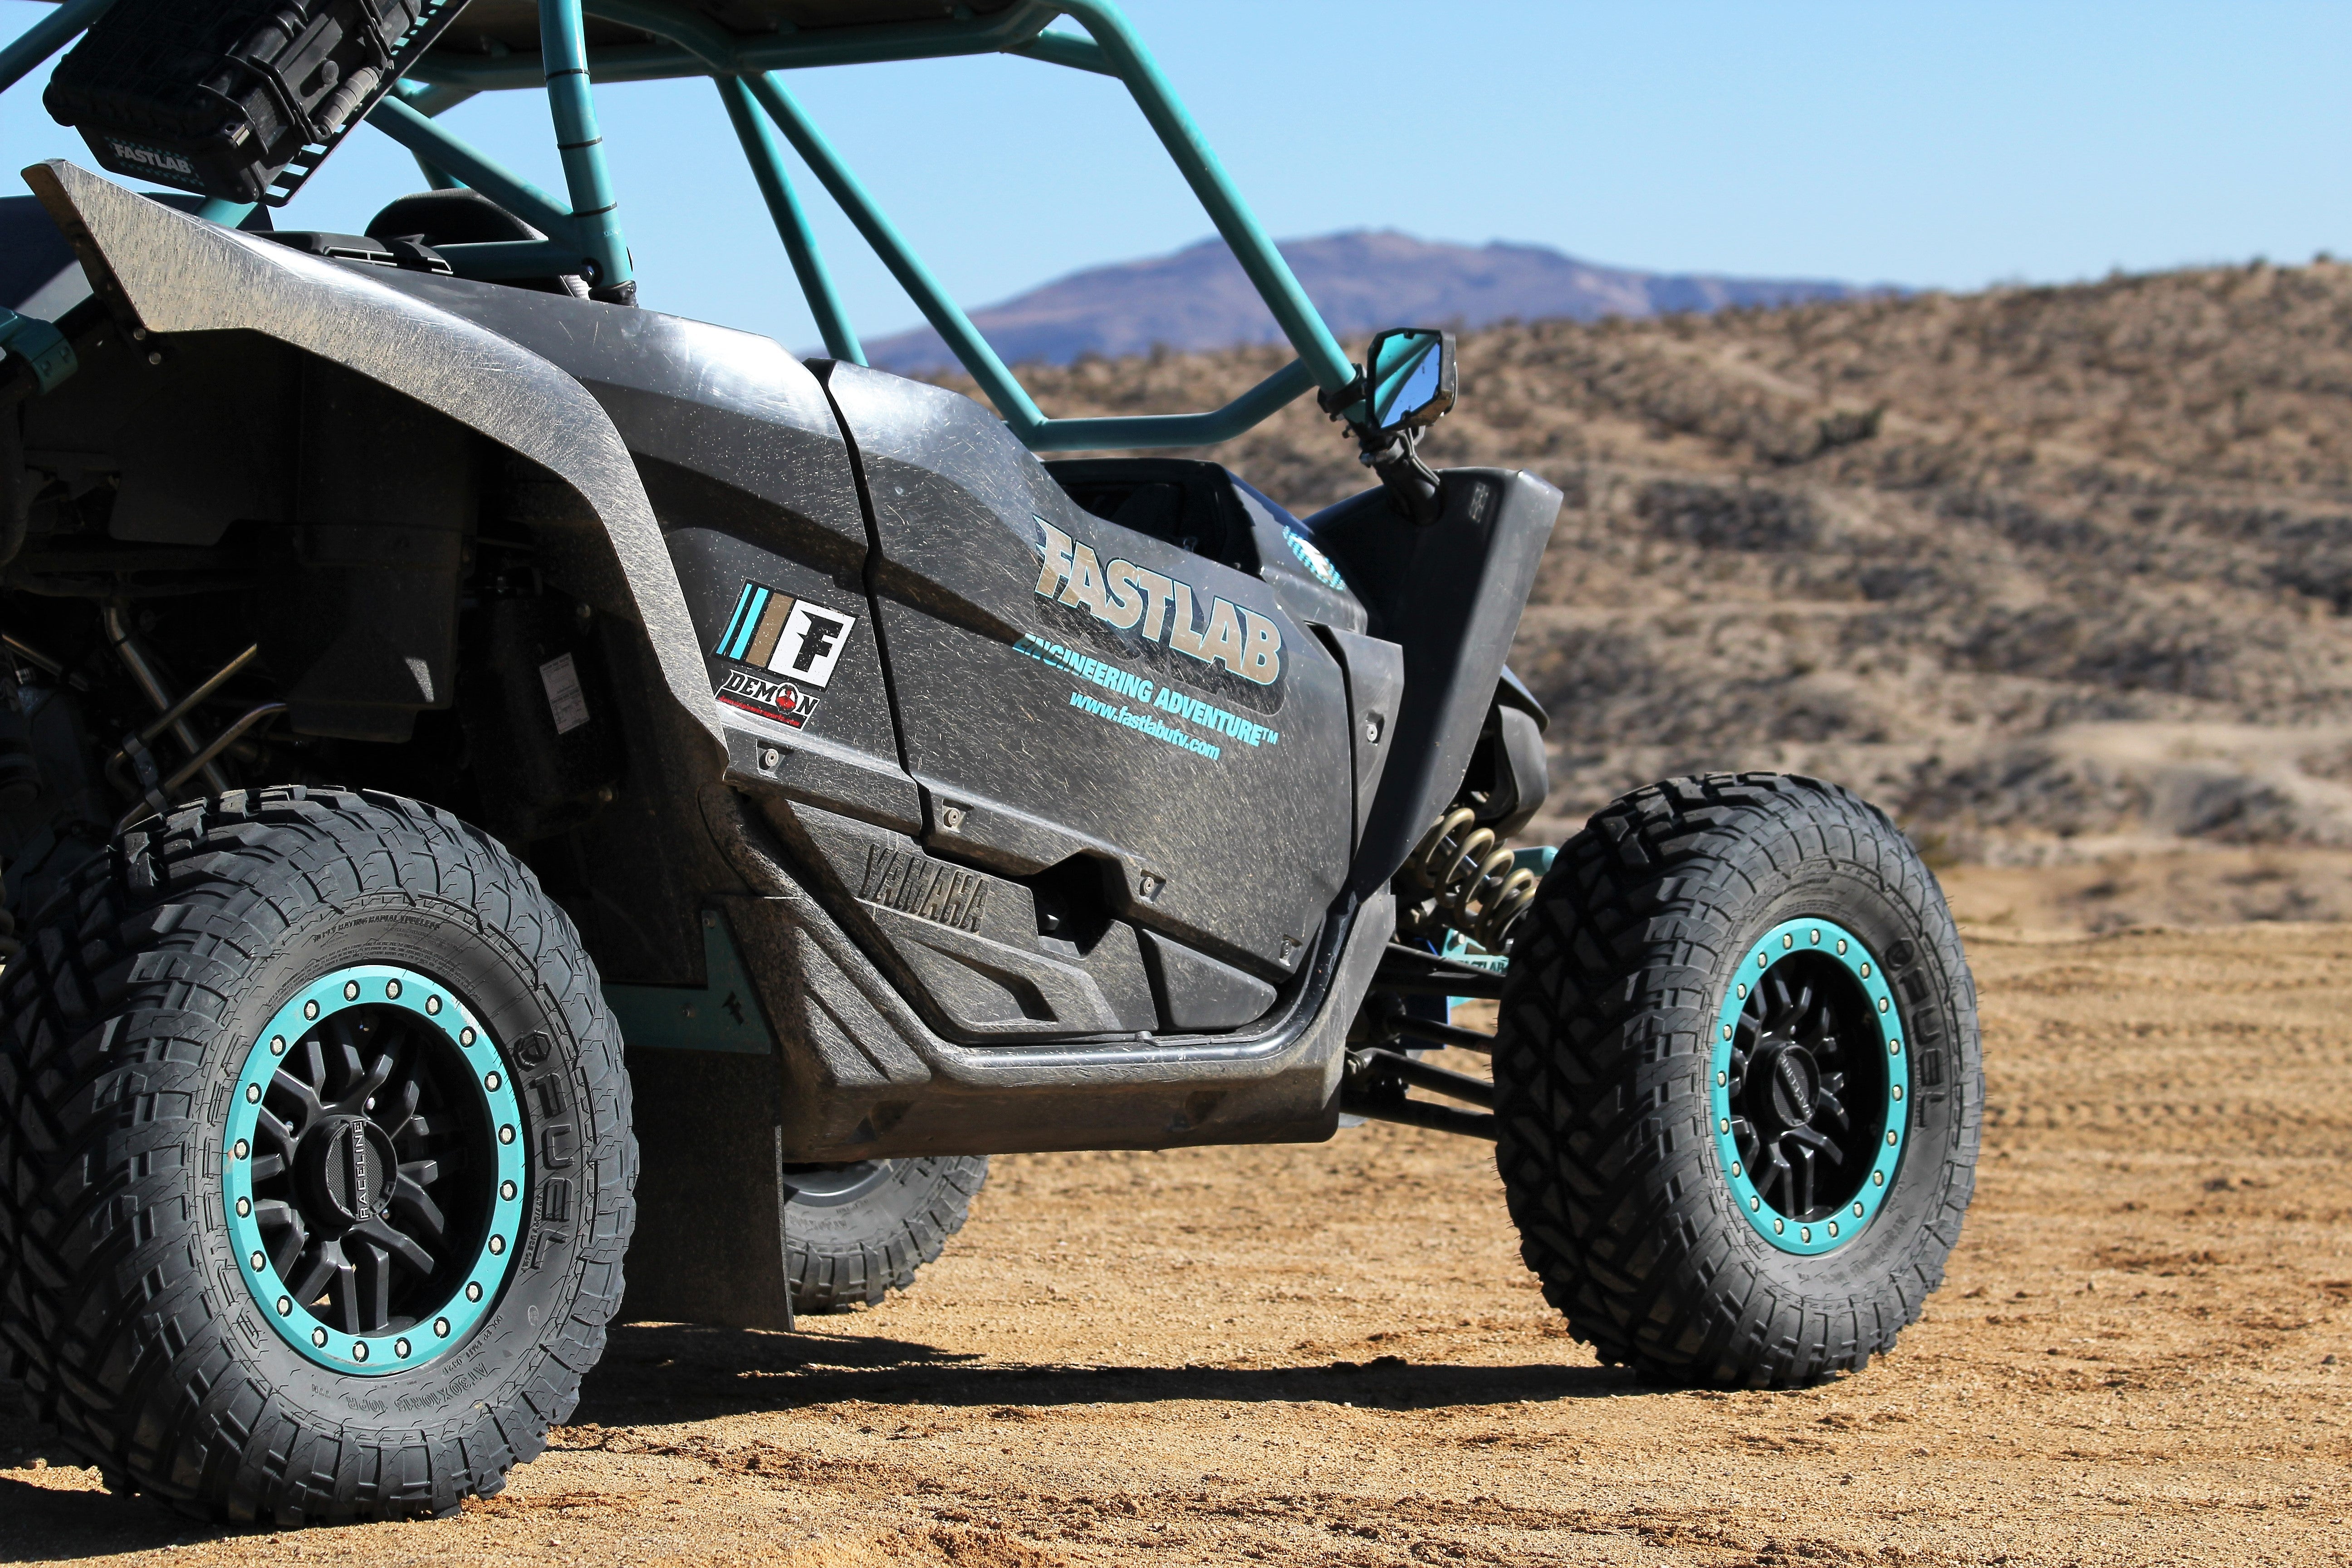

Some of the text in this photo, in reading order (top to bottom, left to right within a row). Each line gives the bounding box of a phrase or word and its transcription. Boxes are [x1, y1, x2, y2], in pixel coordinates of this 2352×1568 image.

[112, 142, 191, 173] FASTLAB
[1032, 514, 1282, 686] FASTLAB
[1012, 633, 1154, 703] ENGINEERING
[1069, 691, 1220, 761] www.fastlabutv.com
[338, 916, 368, 931] RATING
[368, 914, 399, 924] RADIAL
[400, 914, 441, 931] TUBELESS
[858, 843, 990, 933] YAMAHA
[1899, 966, 1945, 1129] FUEL
[353, 1121, 370, 1220] RACELINE
[529, 1073, 574, 1270] FUEL
